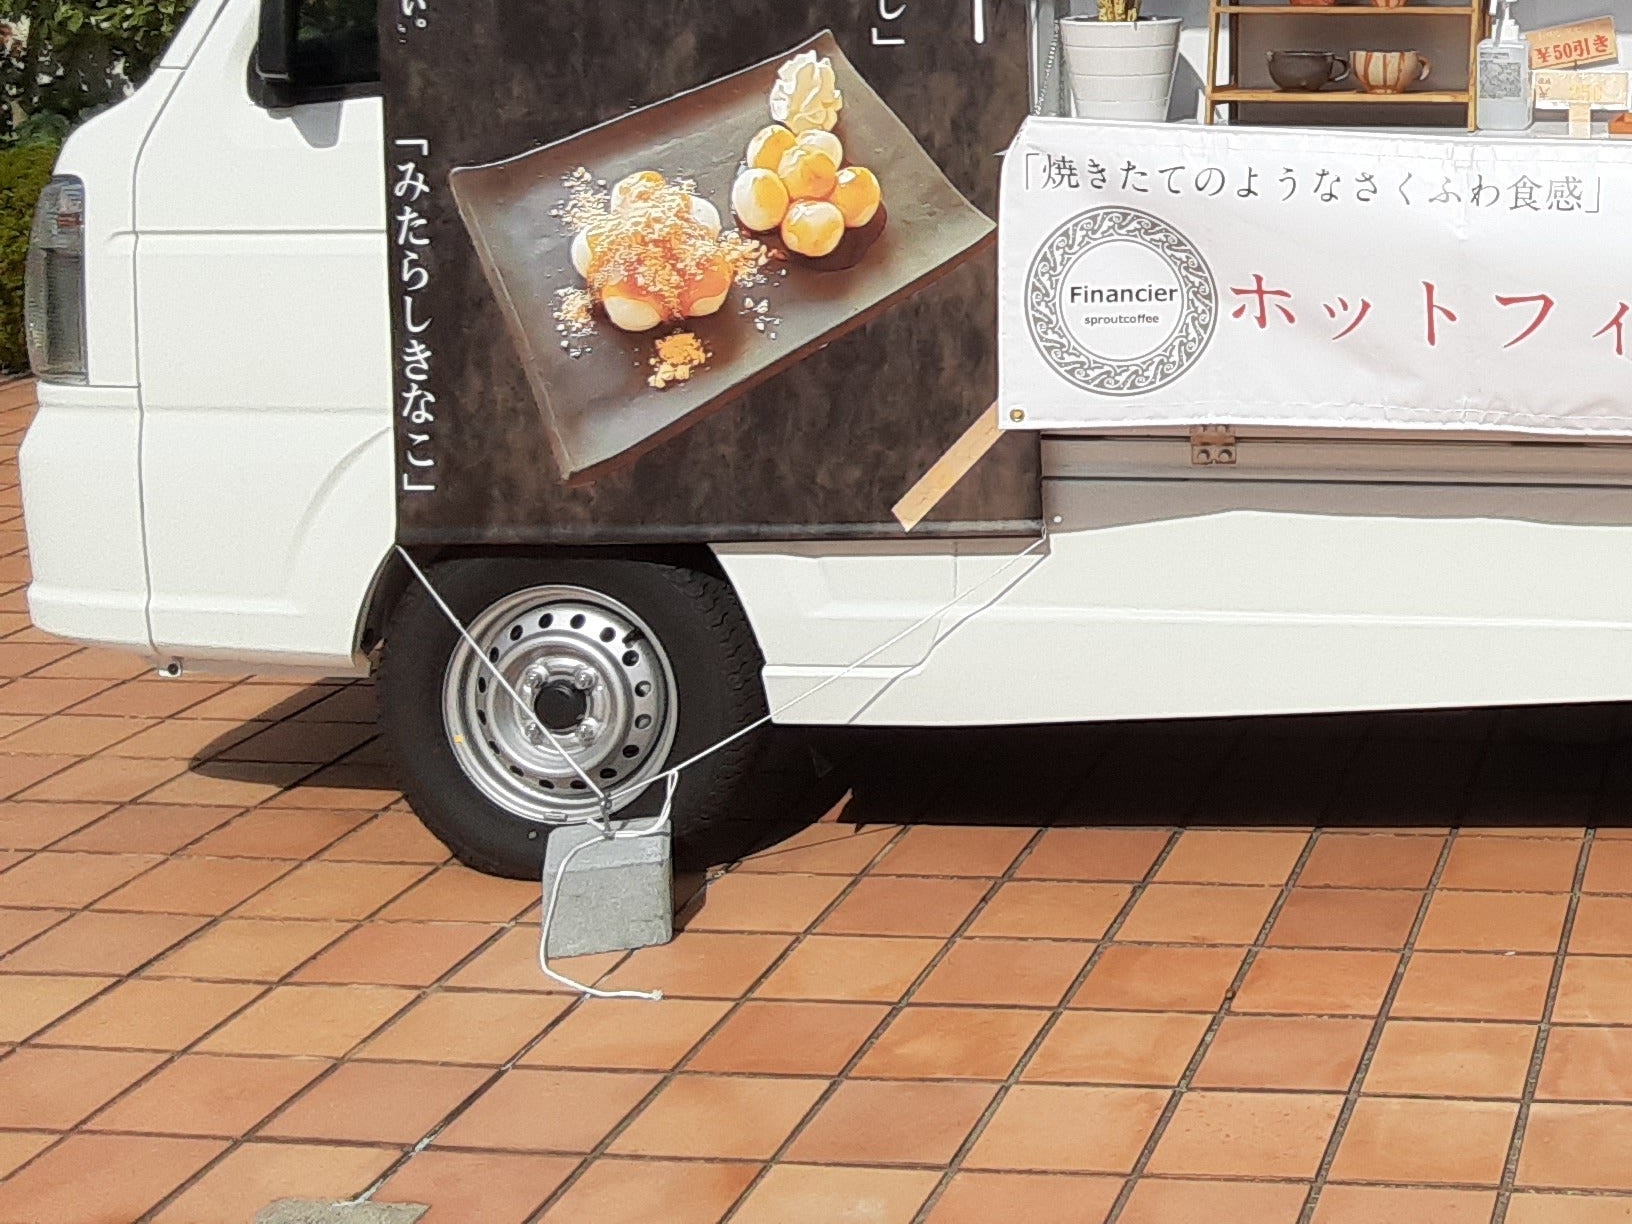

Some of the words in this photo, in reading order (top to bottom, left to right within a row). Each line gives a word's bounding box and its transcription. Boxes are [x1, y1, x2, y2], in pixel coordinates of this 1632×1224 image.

[1024, 152, 1603, 215] 「焼きたてのようなさくふわ食感」
[393, 137, 436, 491] 「みたらしきなこ」
[1070, 285, 1179, 304] Financier
[1084, 314, 1160, 327] sproutcoffee
